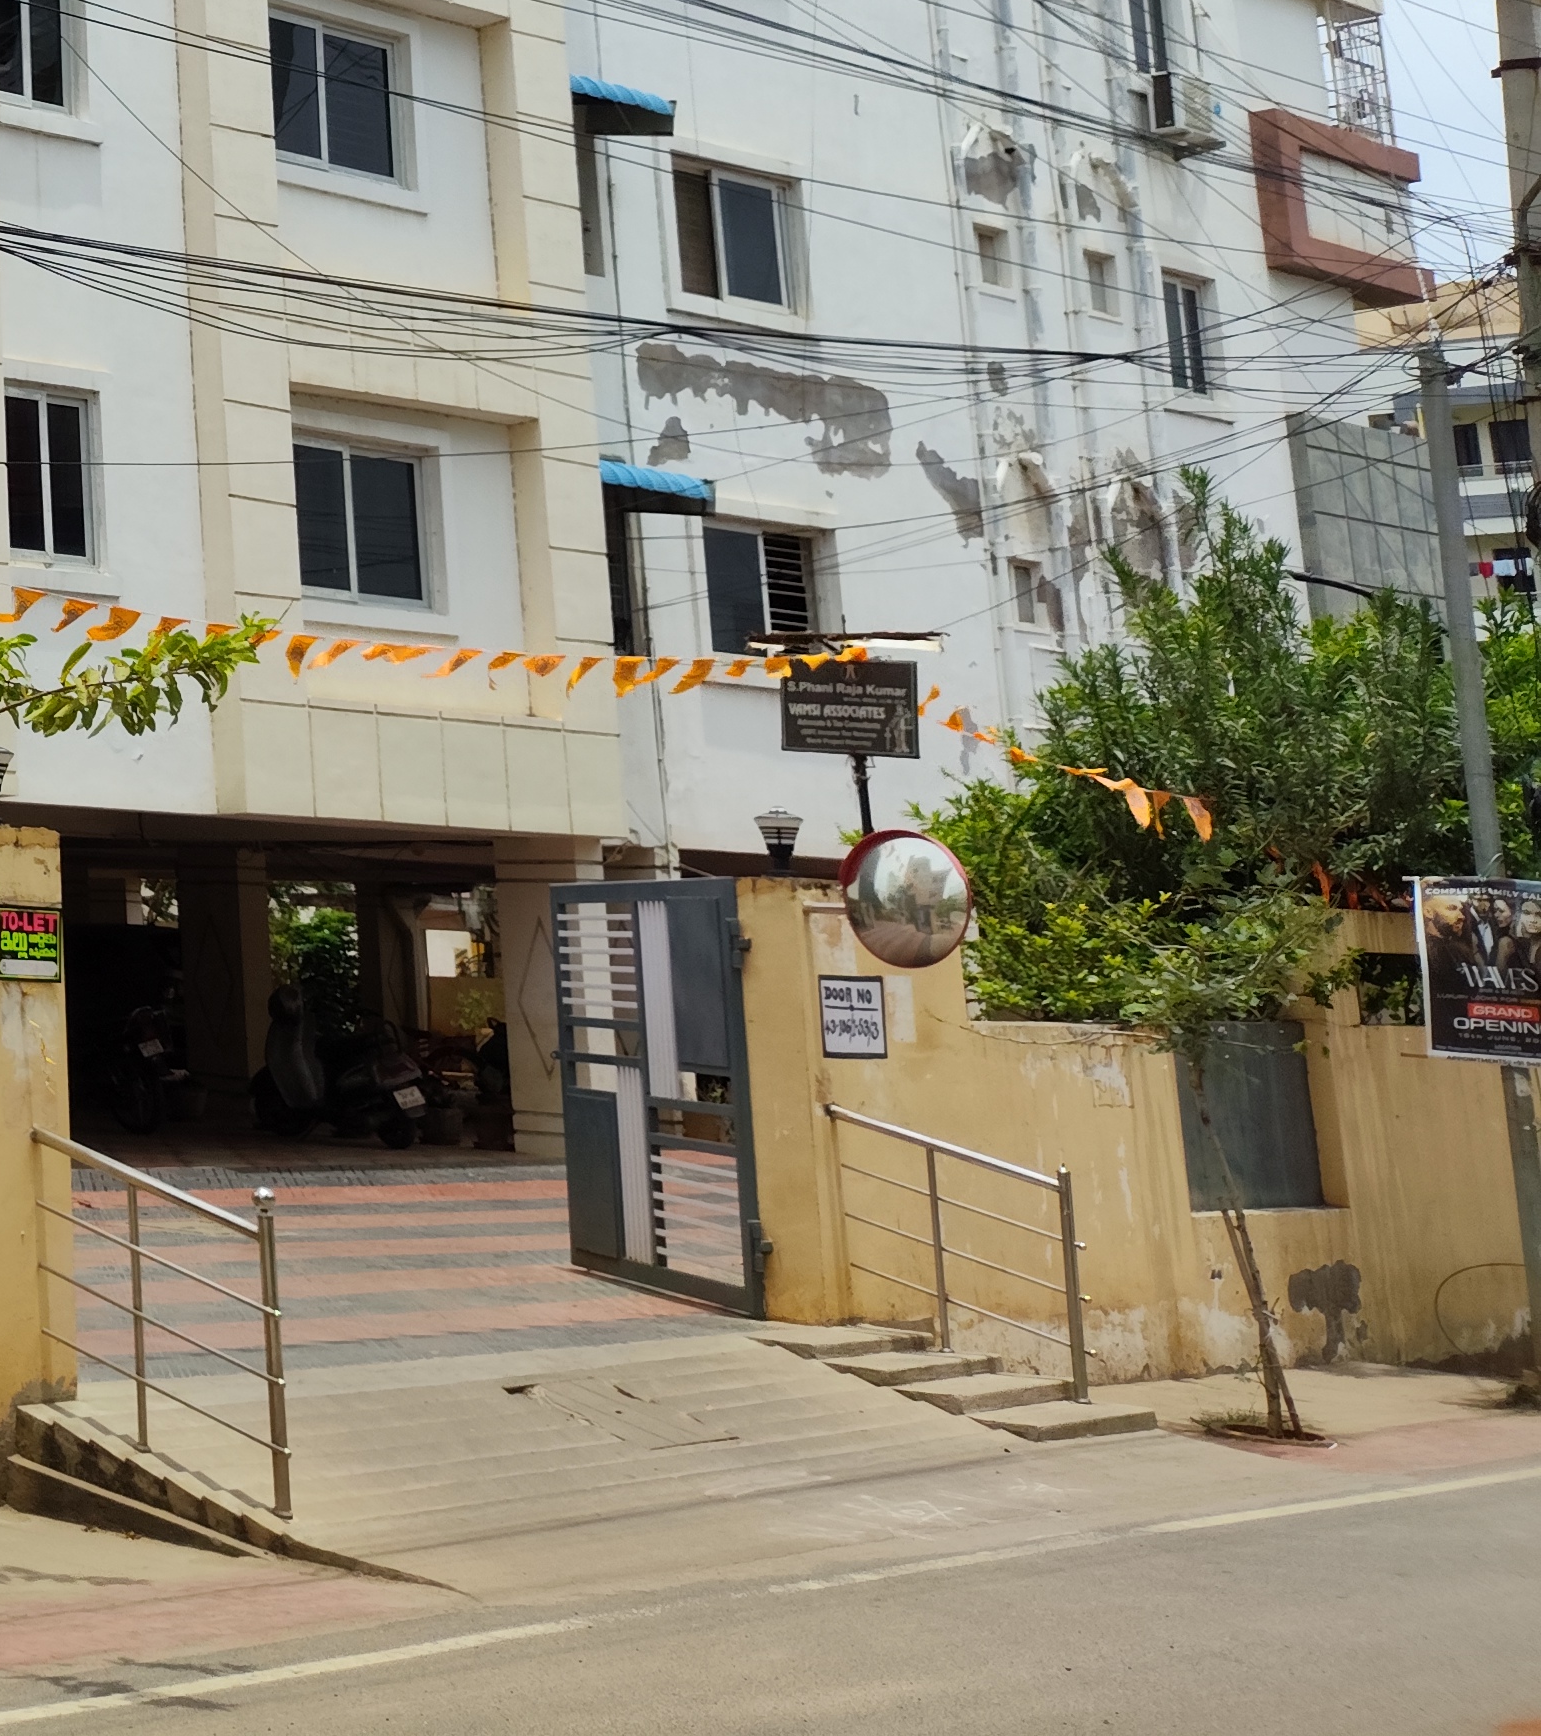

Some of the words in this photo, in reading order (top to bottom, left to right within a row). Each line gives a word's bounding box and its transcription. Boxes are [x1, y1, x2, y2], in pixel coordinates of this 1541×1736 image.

[836, 683, 864, 696] Raja
[865, 684, 907, 697] Kumar
[823, 704, 886, 719] ASSOCIATES
[0, 911, 59, 932] TO-LET
[823, 986, 852, 1003] DOOR
[856, 988, 872, 1004] NO
[1472, 1005, 1533, 1019] GRAND
[1454, 1017, 1541, 1034] OPENIN
